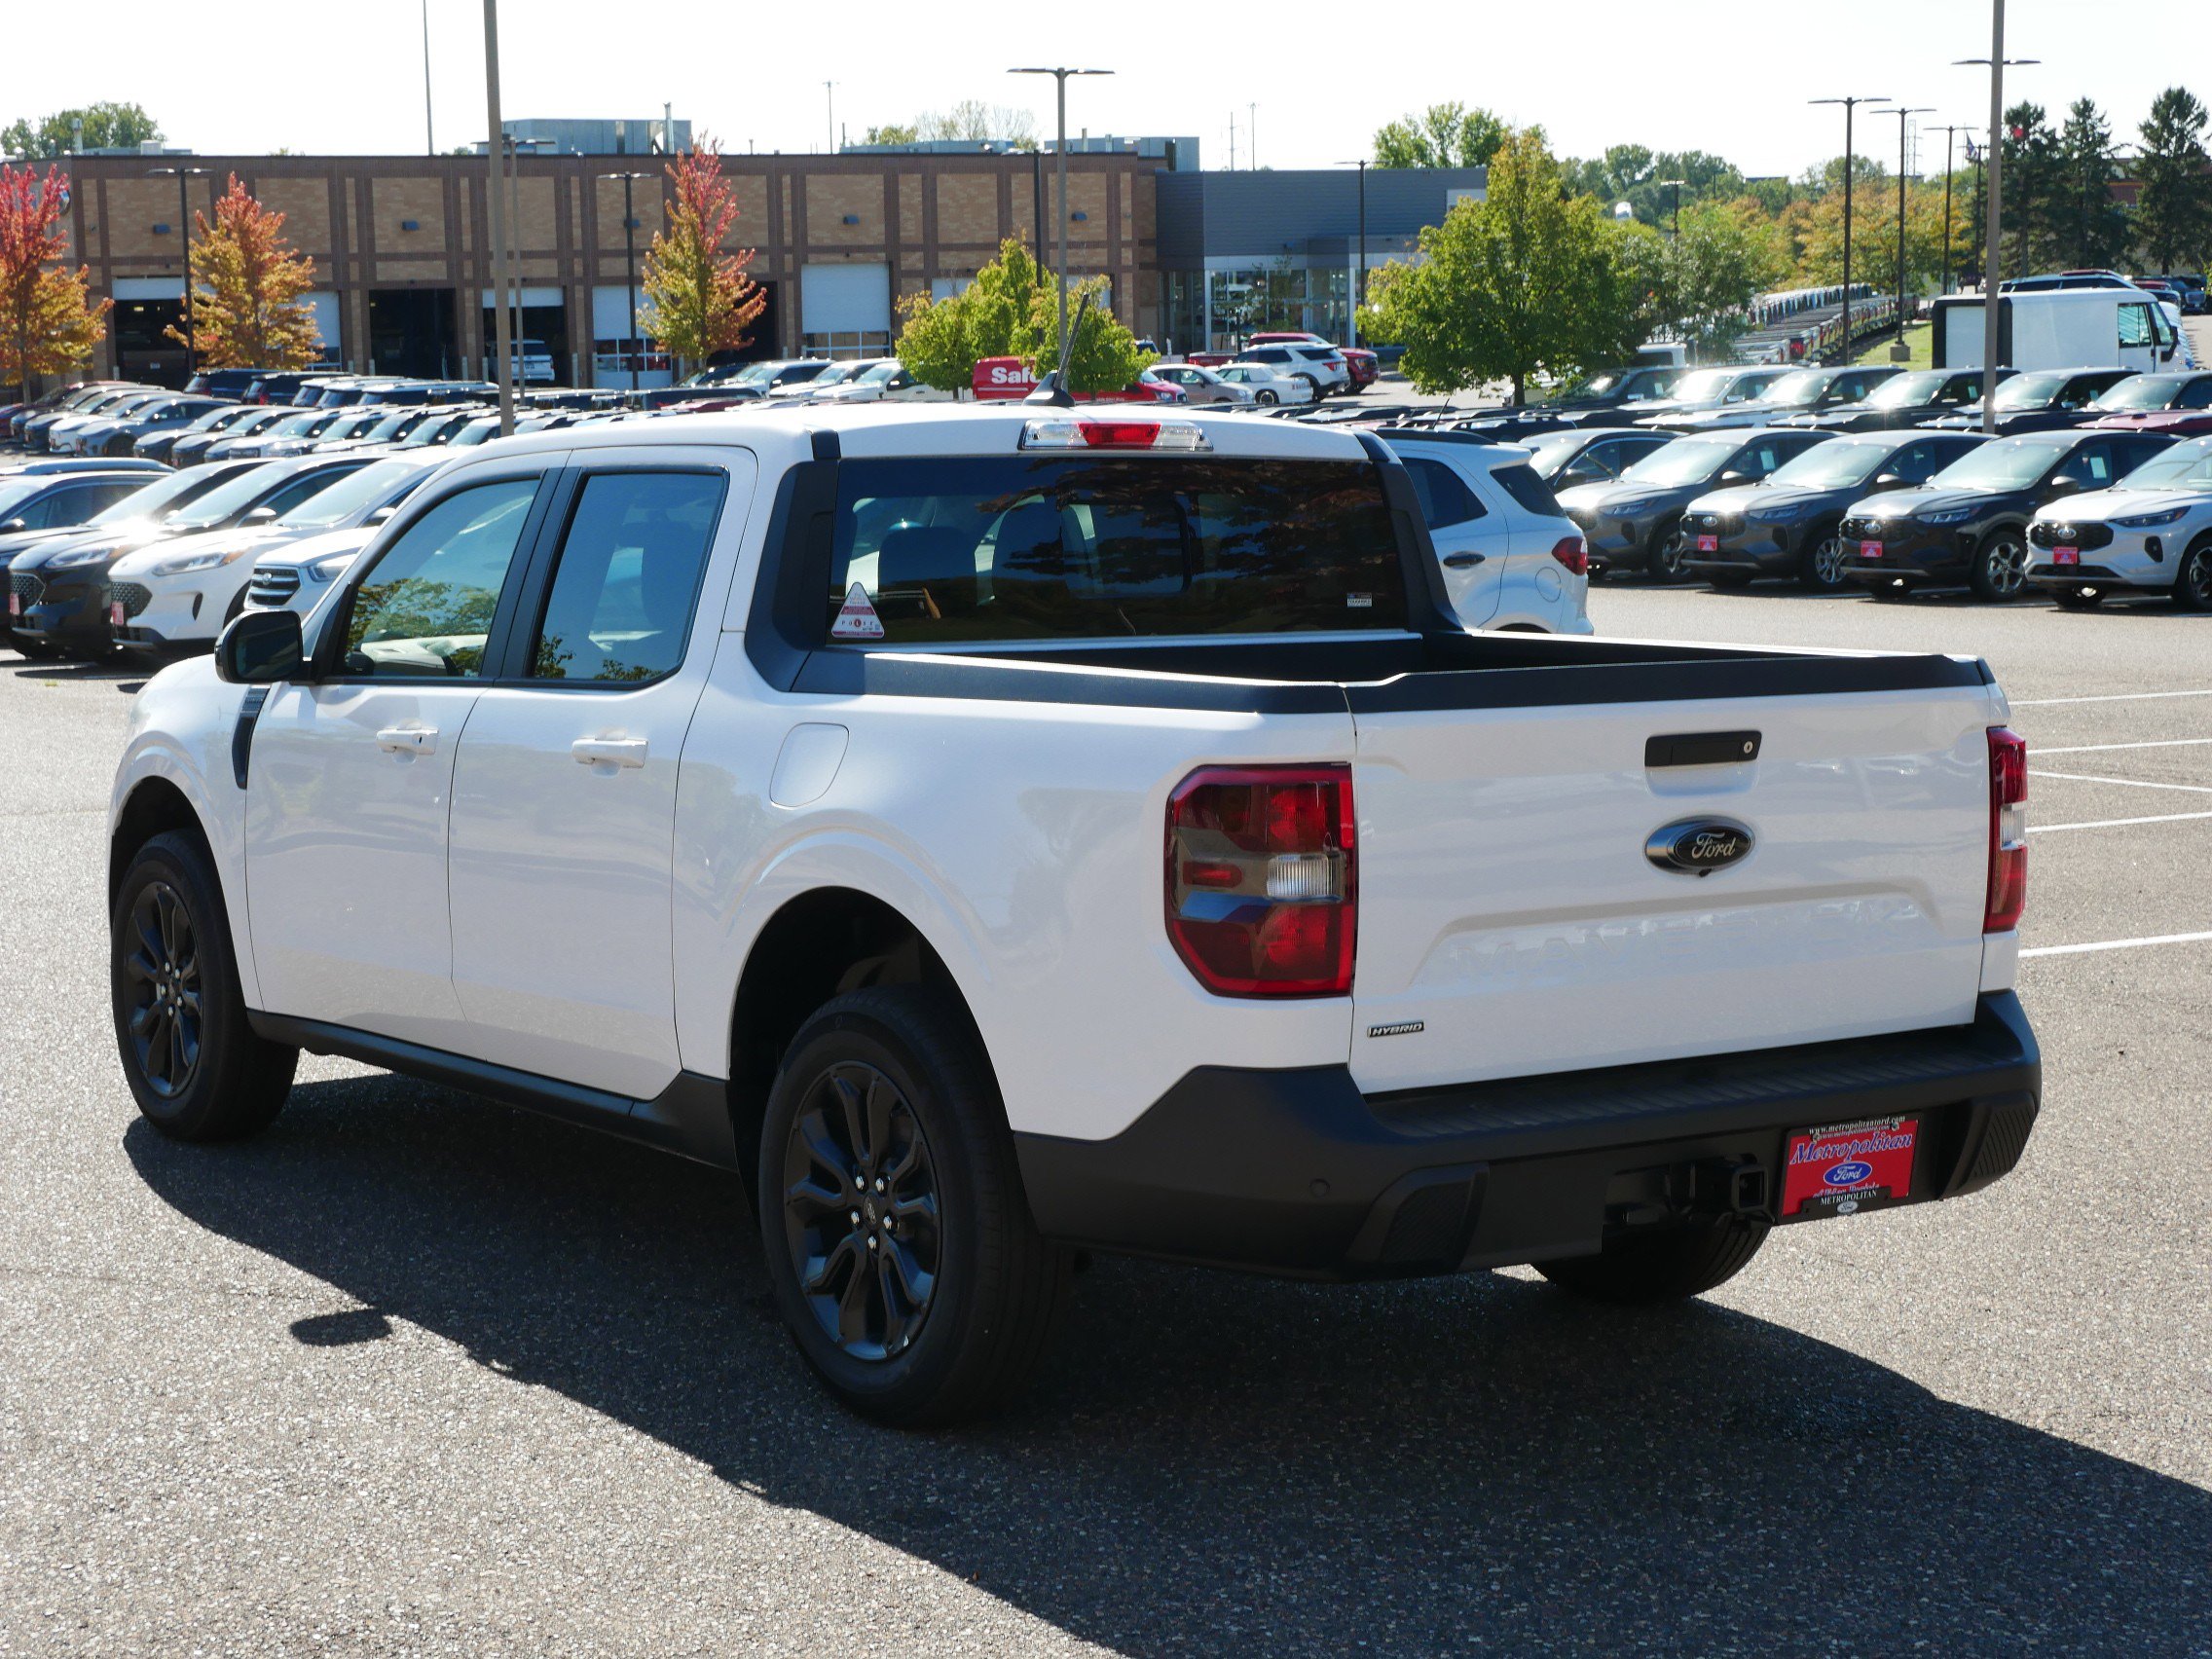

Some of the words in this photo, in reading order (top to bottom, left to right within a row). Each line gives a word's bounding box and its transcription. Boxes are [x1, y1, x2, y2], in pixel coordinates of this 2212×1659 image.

[1691, 831, 1736, 859] Ford
[1372, 1022, 1422, 1036] HYBRID
[1809, 1115, 1905, 1135] www.metropolitanford.com
[1789, 1131, 1913, 1164] Metropolitan
[1833, 1163, 1862, 1181] Ford
[1820, 1190, 1877, 1205] METROPOLITAN
